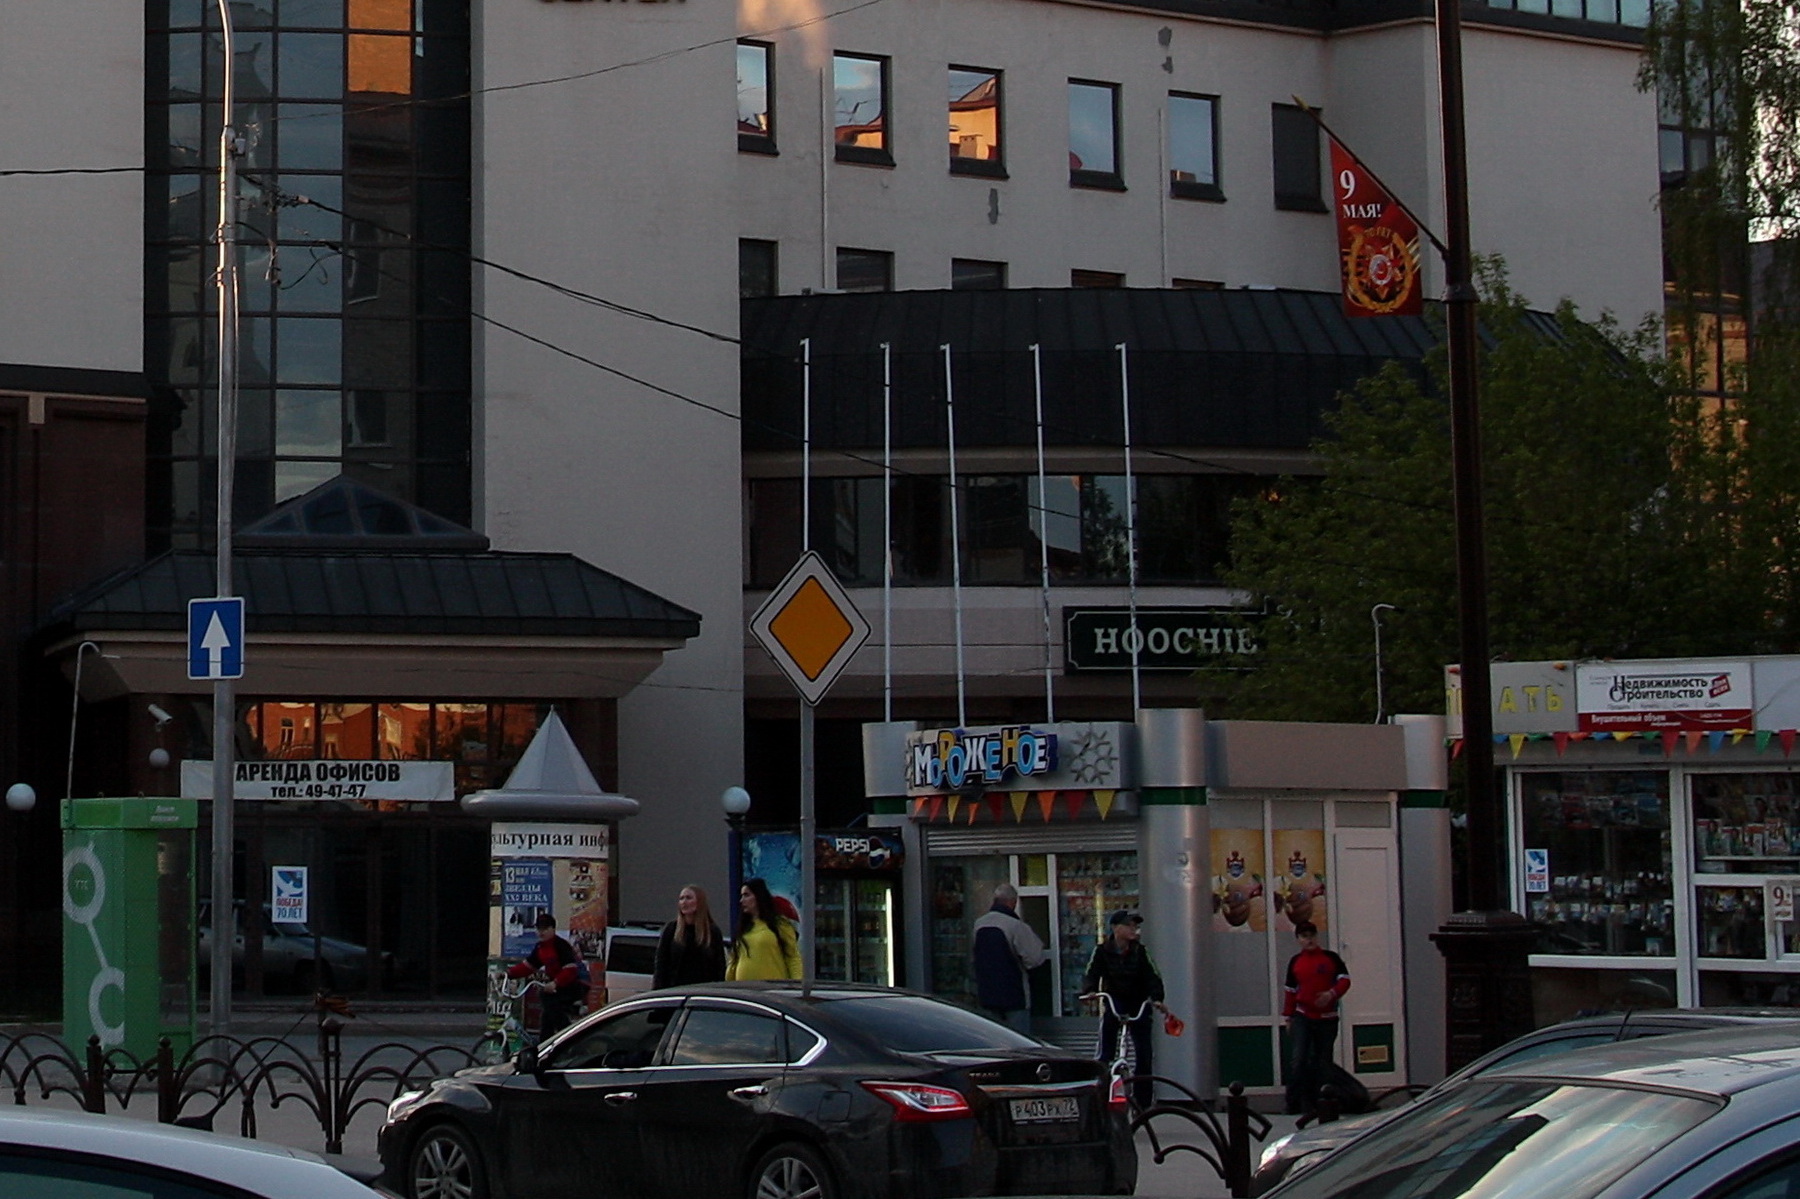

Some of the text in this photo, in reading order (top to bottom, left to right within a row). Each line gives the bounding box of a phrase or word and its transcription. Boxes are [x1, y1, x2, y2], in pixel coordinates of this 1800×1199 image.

[1339, 169, 1356, 200] 9
[1342, 204, 1382, 219] МАЯ!
[1093, 627, 1259, 655] HOOCHIE
[1612, 675, 1708, 692] Недвижимость
[1445, 686, 1564, 715] ПАТЬ
[1610, 684, 1704, 702] Строительство
[235, 762, 401, 784] АРЕНДА ОФИСОВ
[271, 784, 366, 798] тел.: 49-47-47
[835, 837, 870, 853] PEPSI
[505, 867, 515, 883] 13
